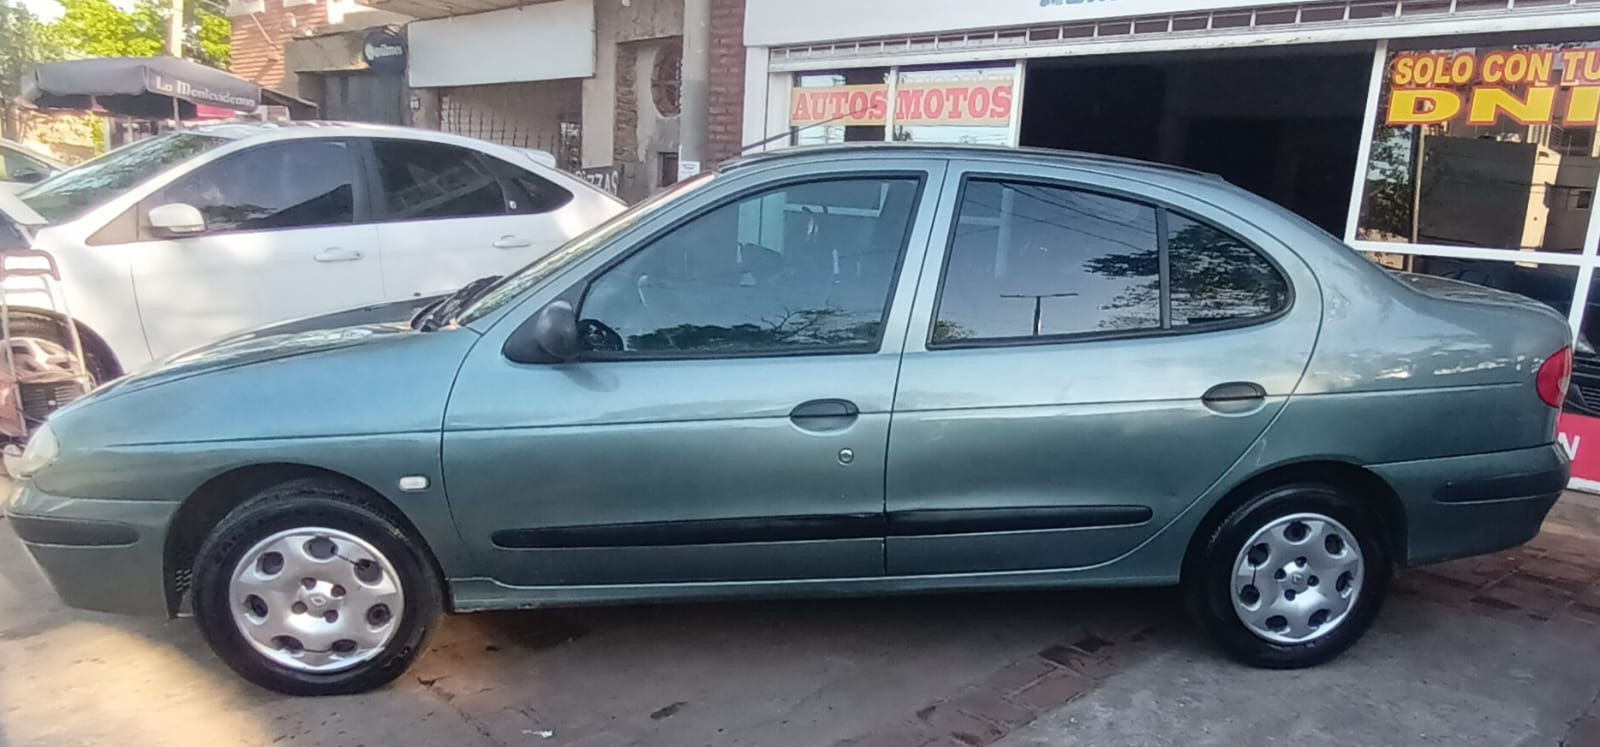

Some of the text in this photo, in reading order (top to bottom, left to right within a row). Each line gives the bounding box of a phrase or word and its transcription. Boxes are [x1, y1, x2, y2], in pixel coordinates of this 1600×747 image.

[1394, 54, 1475, 85] SOLO
[1481, 51, 1553, 84] CON
[792, 86, 1012, 121] AUTOS MOTOS
[1387, 86, 1600, 125] DNI
